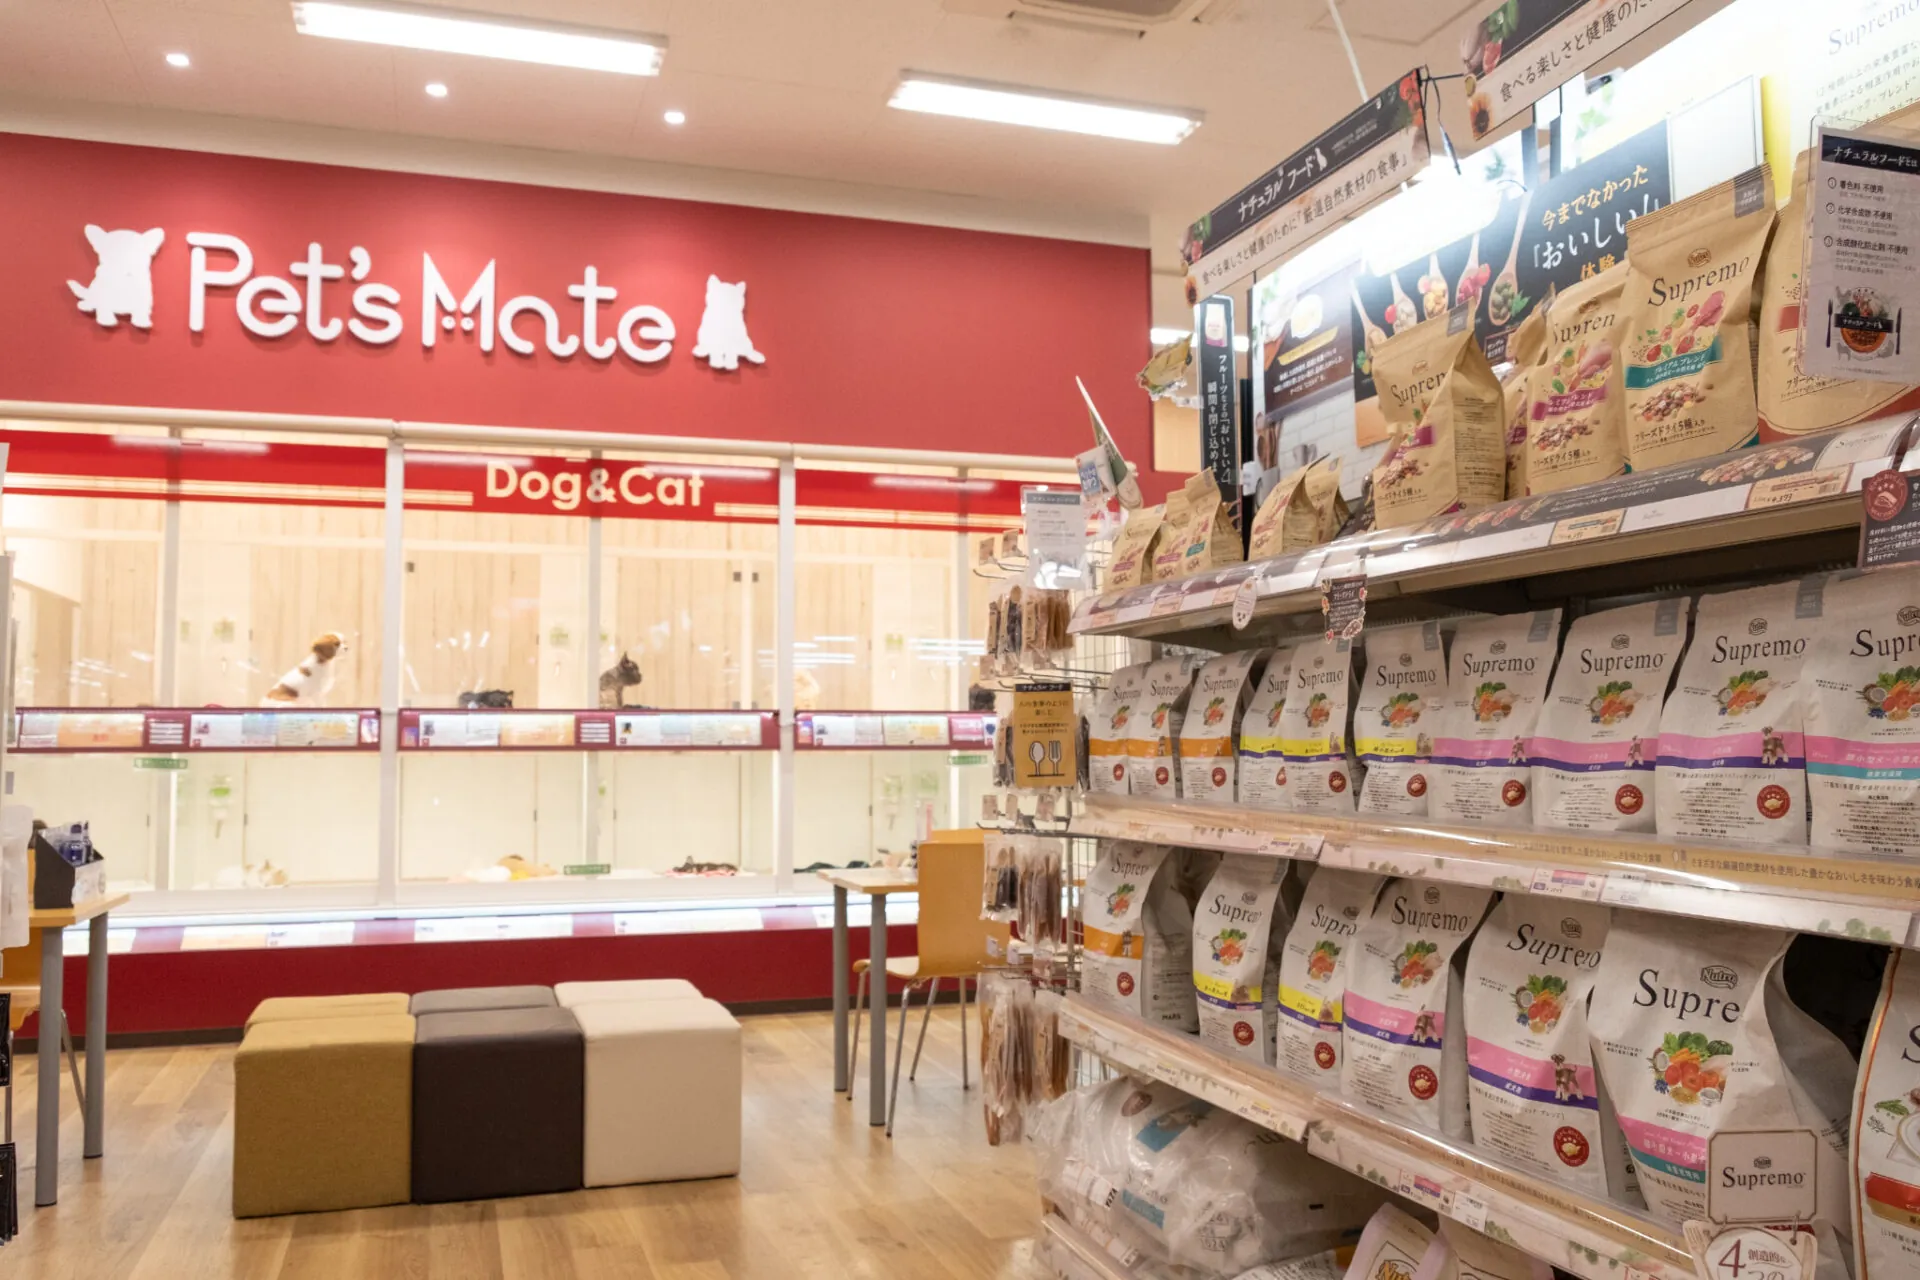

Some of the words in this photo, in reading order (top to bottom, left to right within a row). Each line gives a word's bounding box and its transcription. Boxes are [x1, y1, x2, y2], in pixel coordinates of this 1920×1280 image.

[1541, 164, 1649, 231] 今までなかった
[187, 231, 402, 344] Pet's
[422, 252, 676, 363] Mate
[1648, 254, 1751, 307] Supremo
[486, 460, 704, 511] Dog&Cat
[1463, 653, 1536, 677] Supremo
[1580, 649, 1664, 676] Supremo
[1712, 636, 1807, 665] Supremo
[1297, 668, 1344, 690] Supremo
[1376, 665, 1437, 689] Supremo
[1391, 896, 1467, 933] Supremo
[1633, 968, 1741, 1024] Supre
[1722, 1166, 1804, 1191] Supremo
